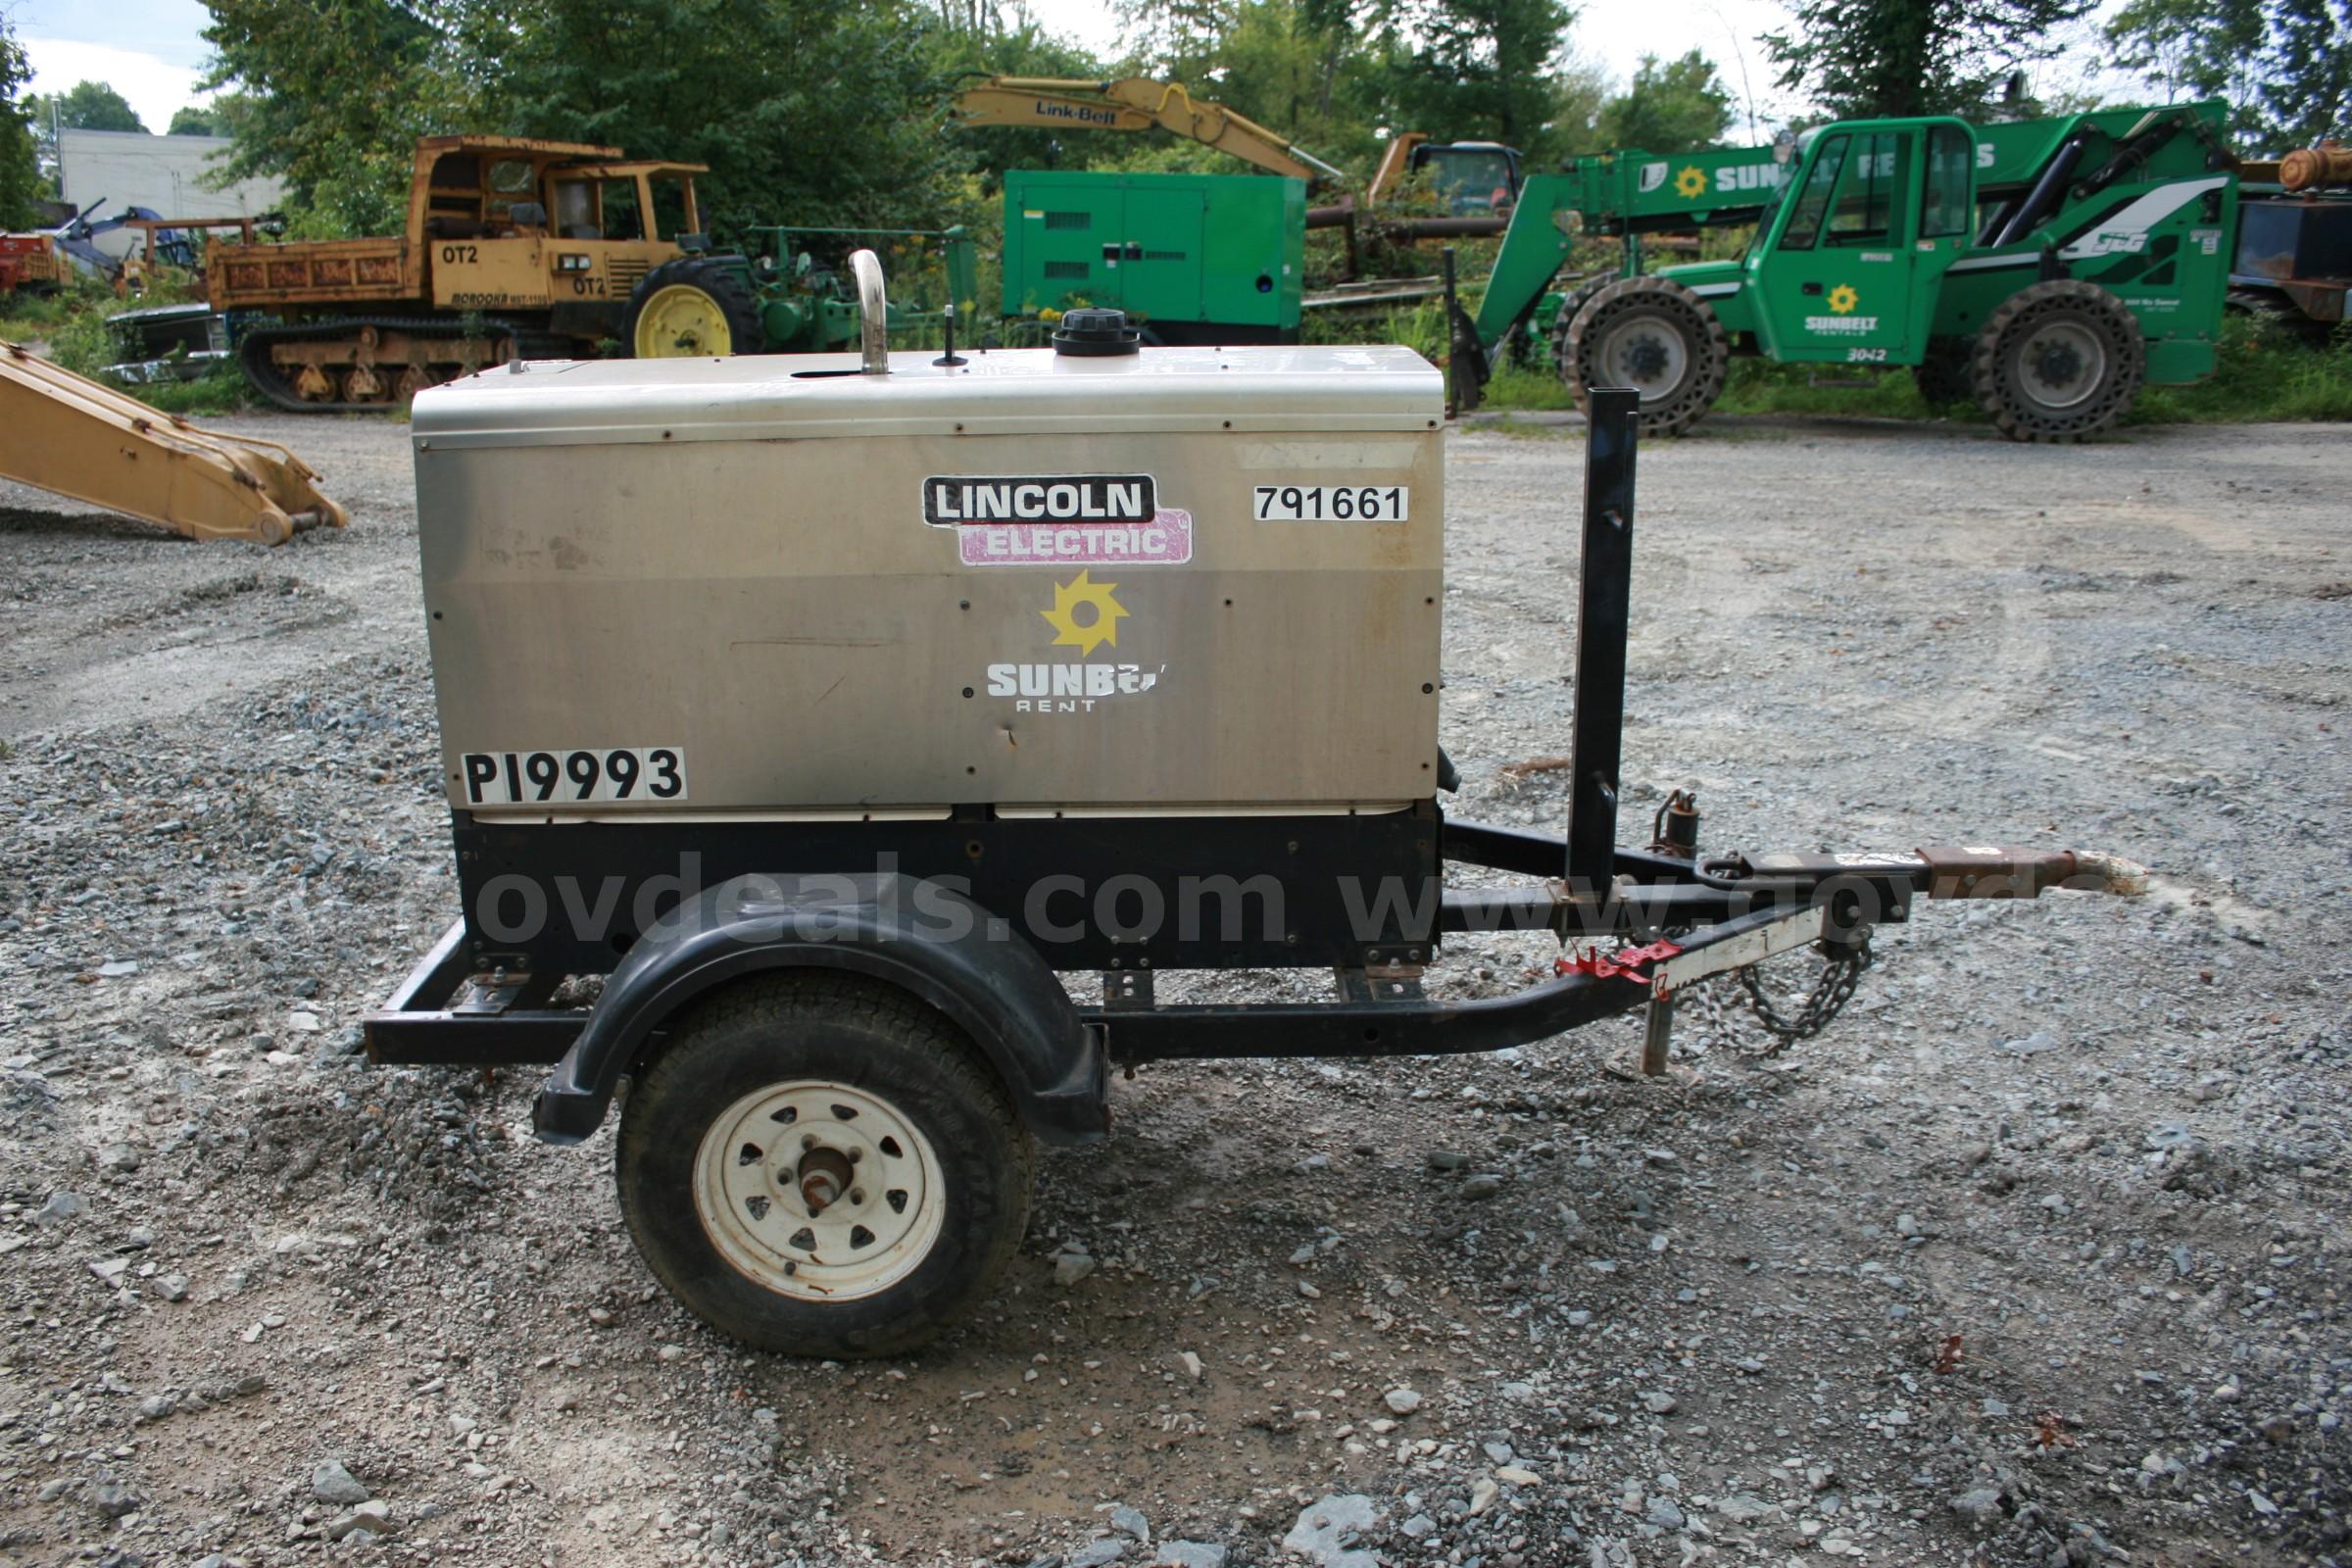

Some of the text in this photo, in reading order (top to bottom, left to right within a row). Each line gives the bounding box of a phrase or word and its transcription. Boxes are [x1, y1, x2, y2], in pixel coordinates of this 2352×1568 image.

[442, 246, 478, 264] OT2
[573, 277, 606, 295] OT2
[1805, 317, 1879, 330] SUNBELT
[1847, 348, 1887, 362] 3042
[935, 483, 1142, 519] LINCOLN
[1255, 486, 1403, 520] 791661
[987, 528, 1167, 556] ELECTRIC
[987, 663, 1166, 697] SUNBE
